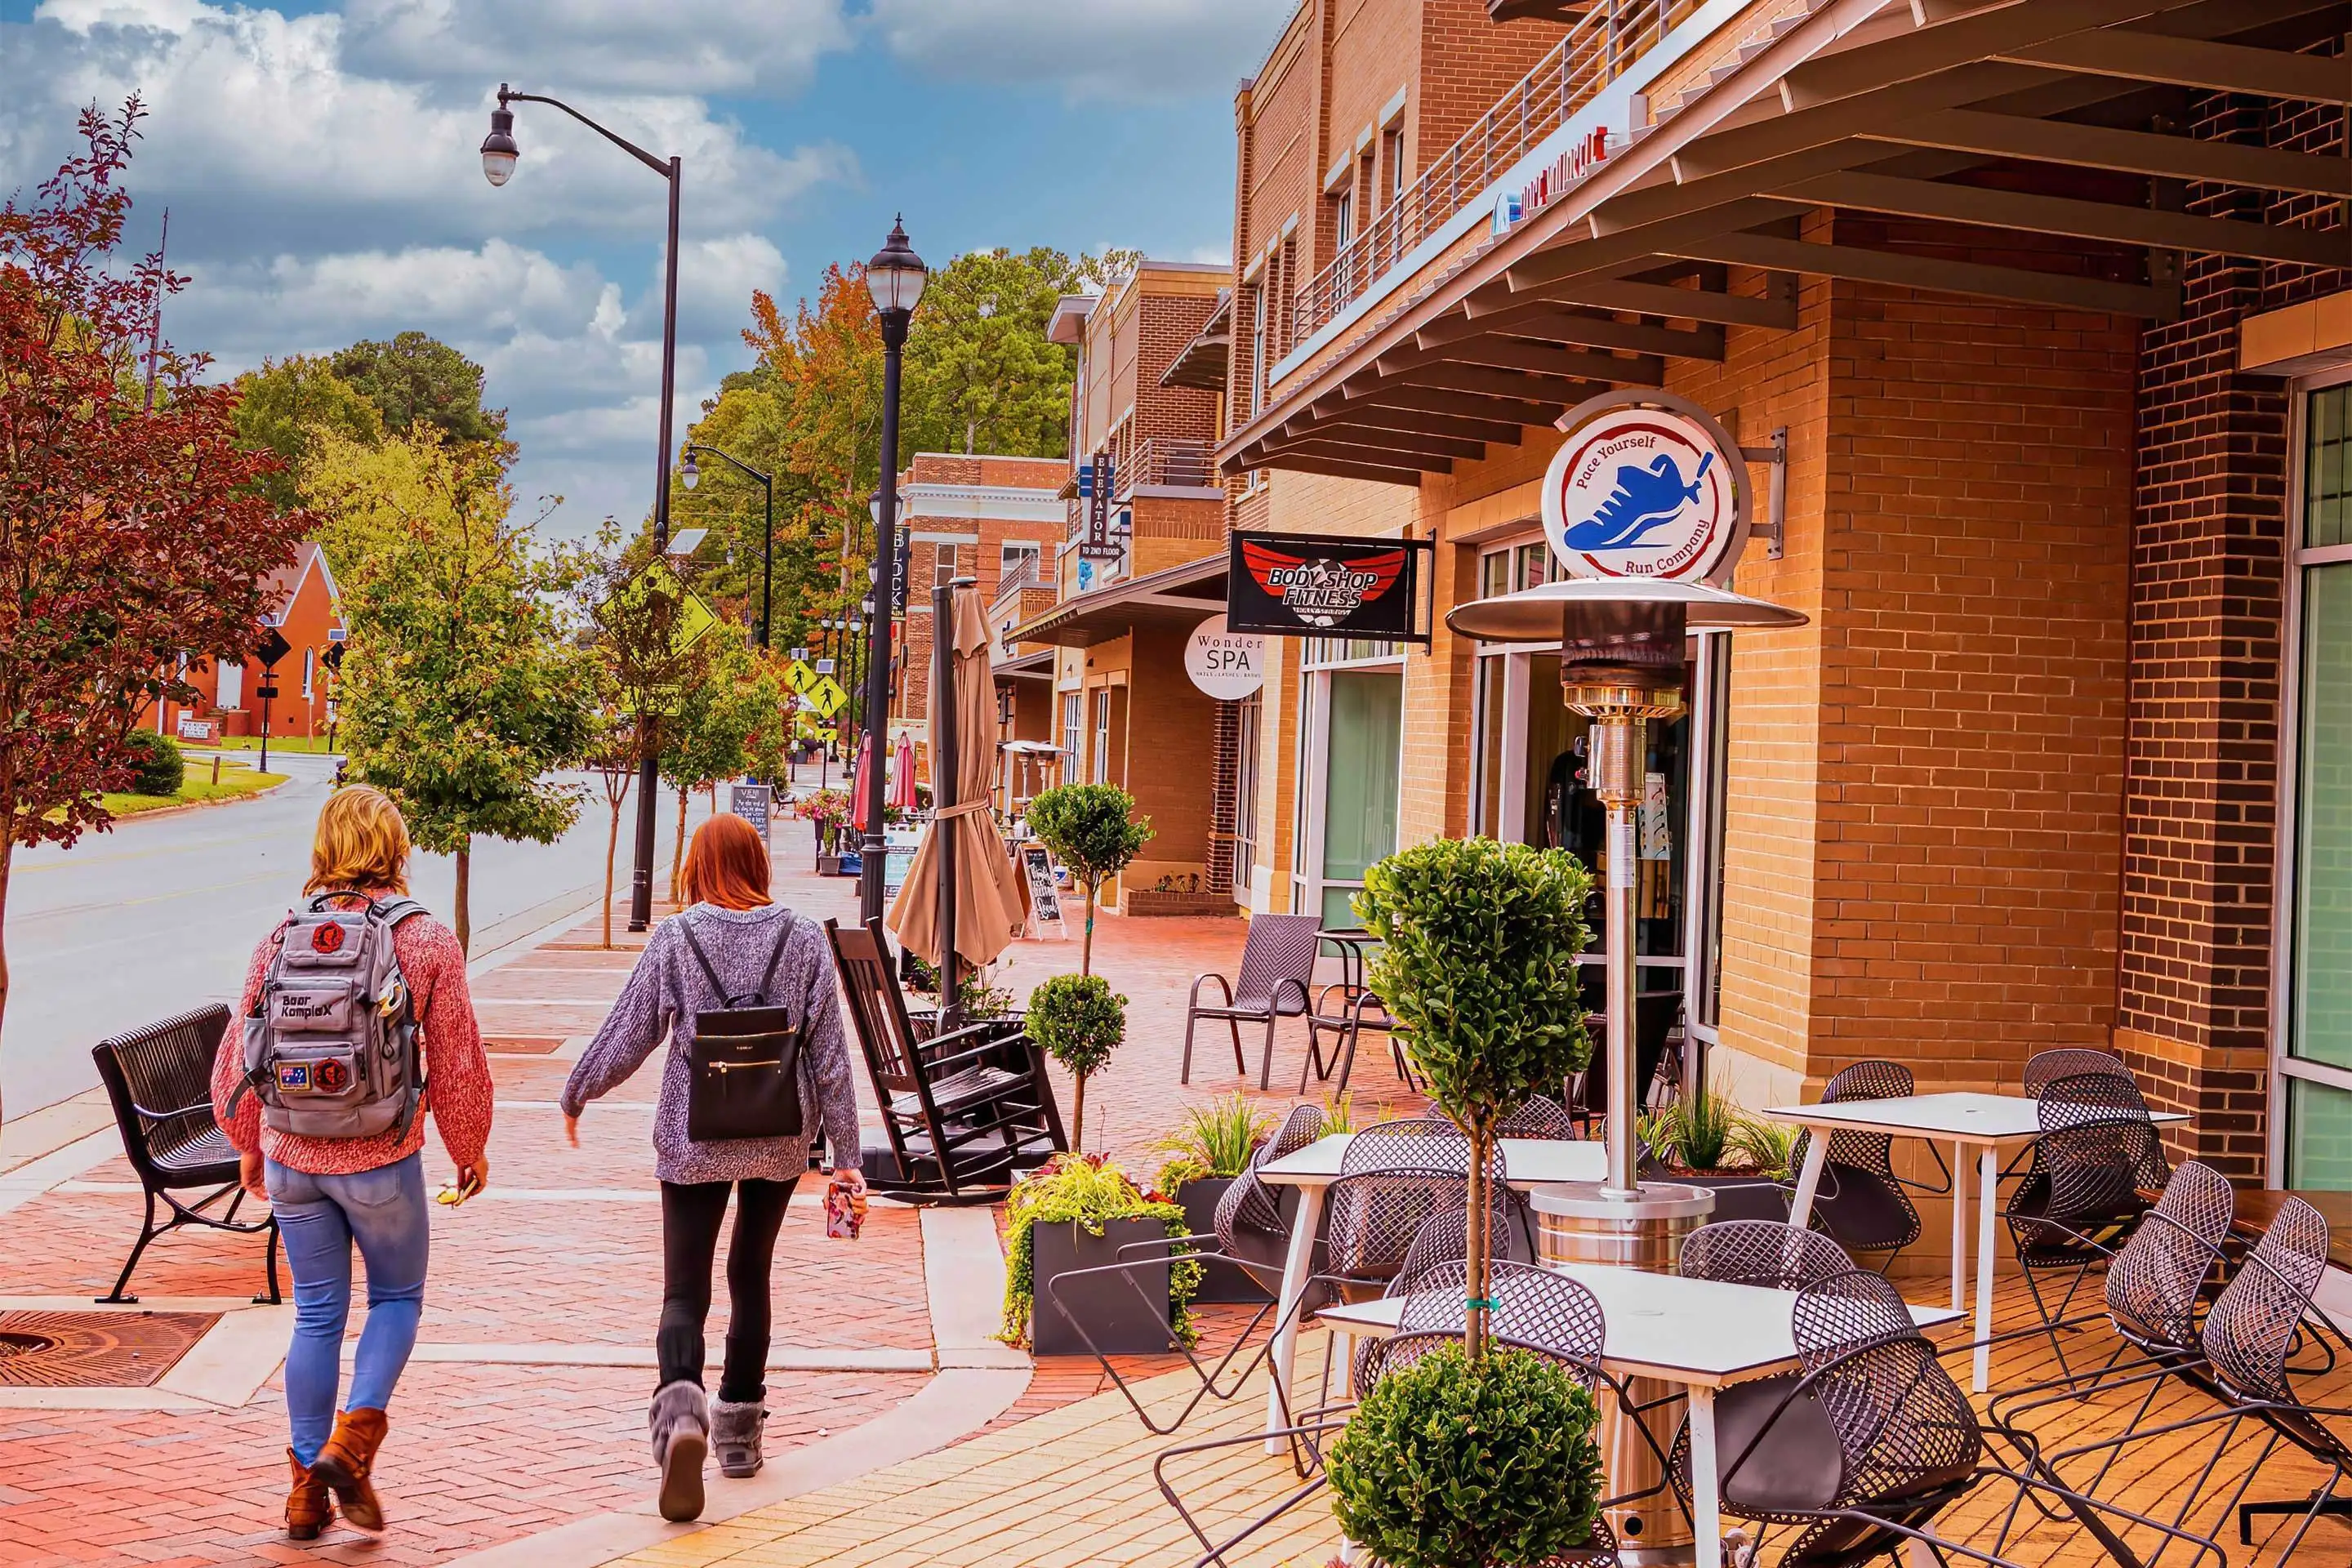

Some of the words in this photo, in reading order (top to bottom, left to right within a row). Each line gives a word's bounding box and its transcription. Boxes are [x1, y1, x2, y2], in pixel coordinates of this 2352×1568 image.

[1576, 457, 1601, 489] Pace
[1597, 435, 1657, 459] Yourself
[1094, 457, 1105, 541] ELEVATOR
[1082, 546, 1089, 555] TO
[1090, 547, 1102, 555] 2ND
[1102, 547, 1120, 556] FLOOR
[1624, 560, 1654, 574] Run
[1657, 519, 1710, 570] Company
[1267, 568, 1321, 587] BODY
[1324, 571, 1378, 590] SHOP
[1282, 587, 1362, 608] FITNESS
[1197, 635, 1263, 648] Wonder
[1206, 649, 1250, 670] SPA
